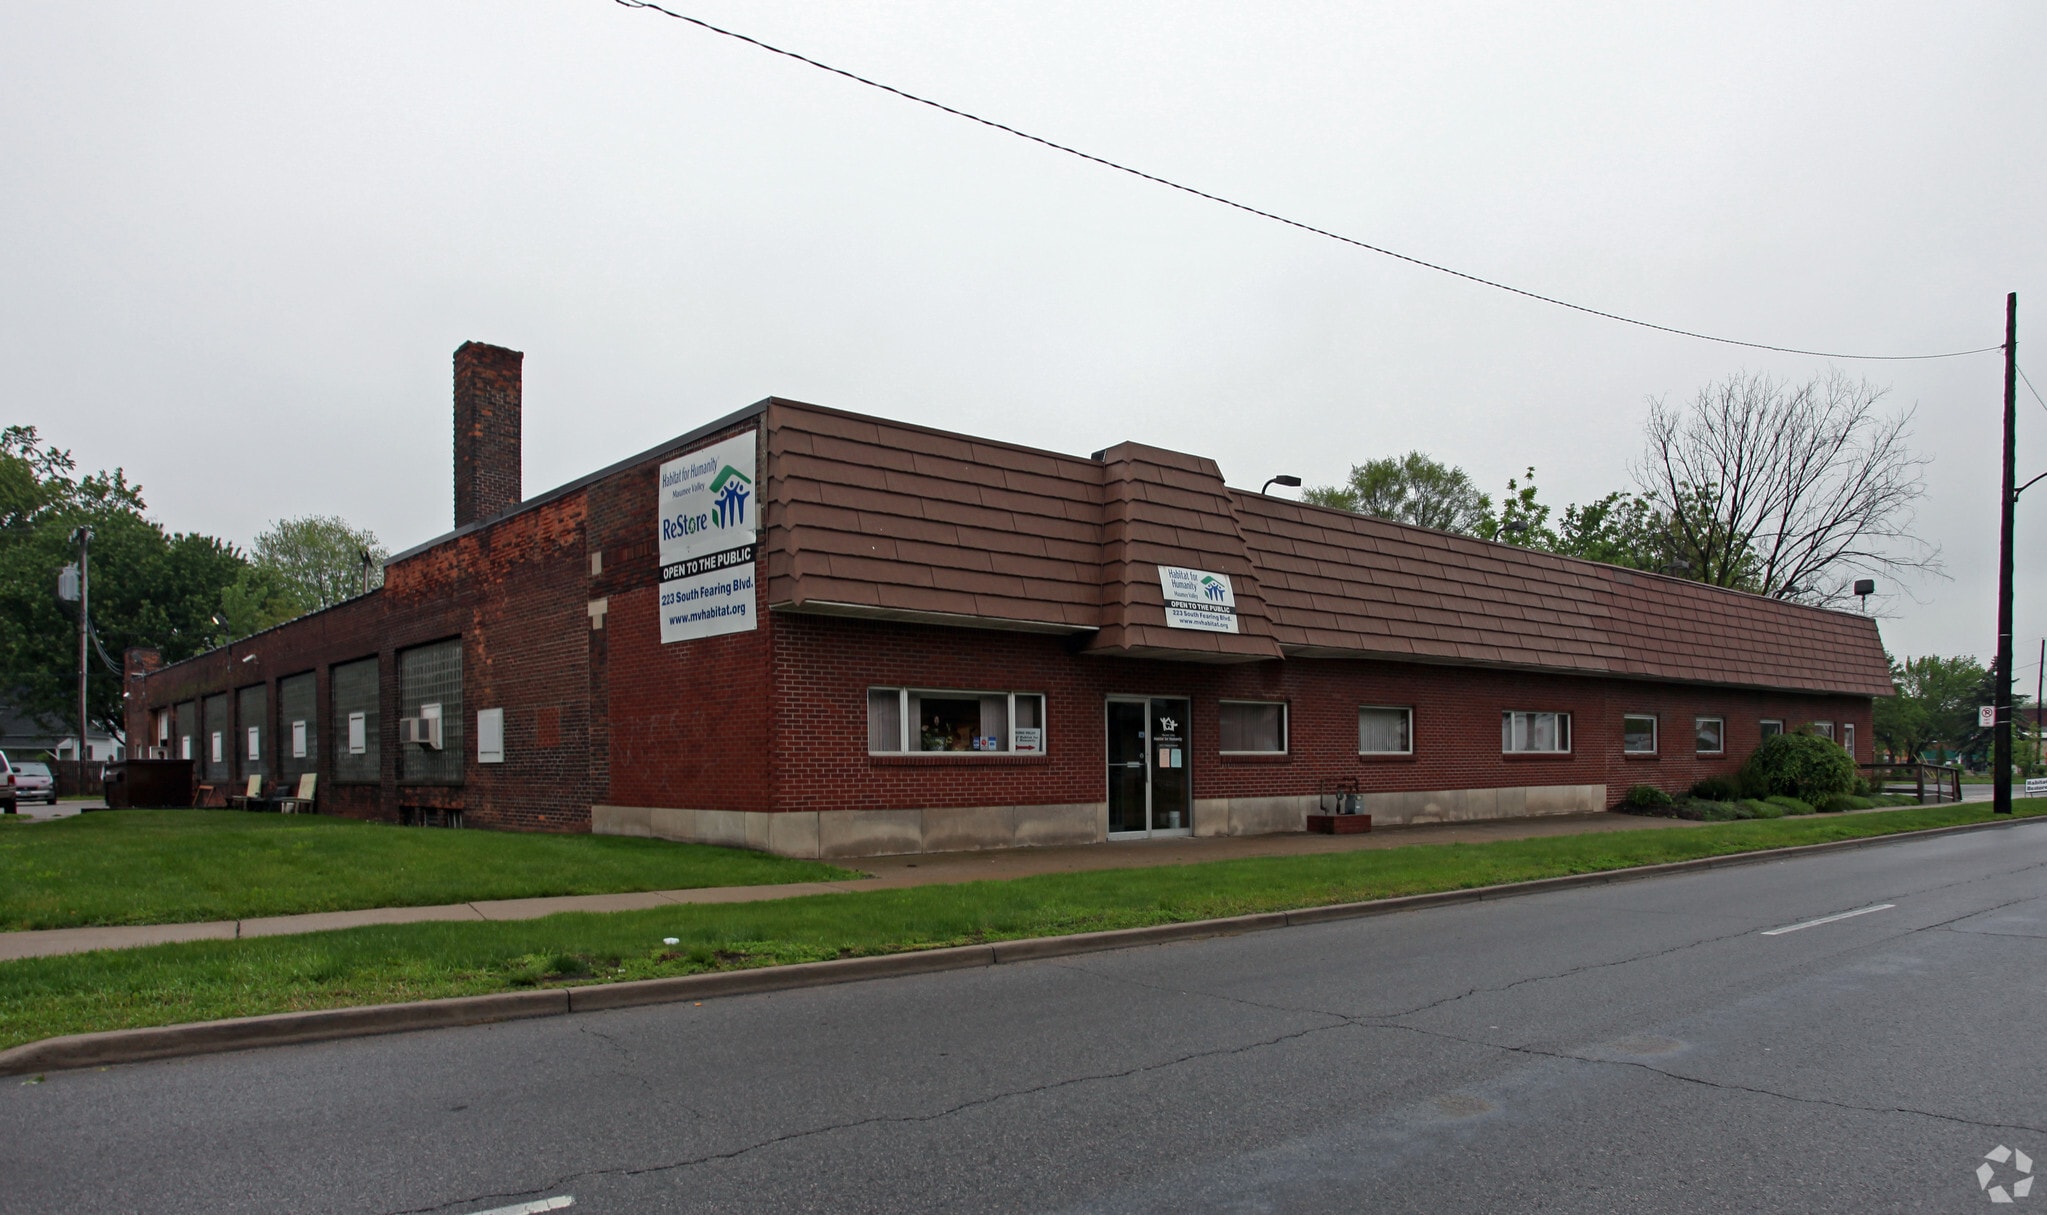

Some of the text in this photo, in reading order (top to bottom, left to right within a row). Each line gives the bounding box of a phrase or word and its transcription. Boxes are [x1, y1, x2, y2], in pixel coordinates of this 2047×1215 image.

[662, 457, 718, 488] Habitat for Humanity
[672, 482, 705, 498] Maumee Valley
[663, 513, 708, 541] ReStore
[663, 547, 751, 580] OPEN TO THE PUBLIC
[1168, 569, 1189, 580] Habitat
[661, 576, 753, 606] 223 South Fearing Blvd.
[1171, 579, 1197, 592] Humanity
[669, 603, 746, 625] www.mvhabitat.org
[1183, 610, 1200, 618] South
[1199, 612, 1220, 621] Fearing
[1188, 602, 1197, 610] TO
[1197, 603, 1209, 611] THE
[1210, 606, 1230, 614] PUBLIC
